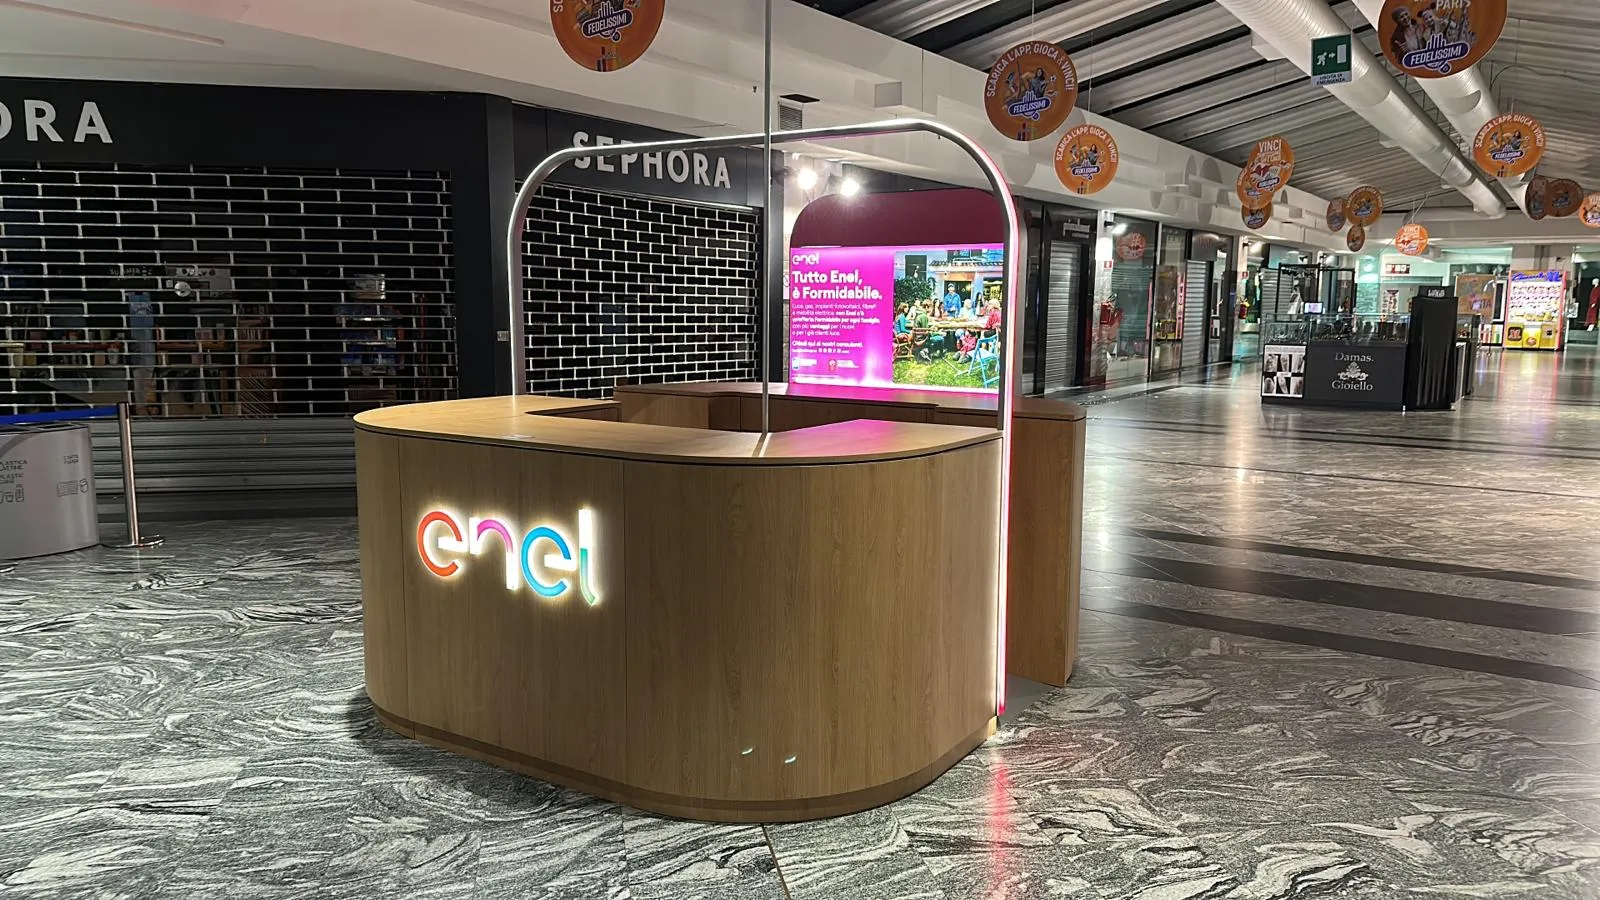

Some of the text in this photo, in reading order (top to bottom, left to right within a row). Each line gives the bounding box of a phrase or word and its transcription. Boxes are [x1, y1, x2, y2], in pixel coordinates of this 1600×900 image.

[588, 17, 627, 34] FEDELISSIMI
[1411, 45, 1462, 65] FEDELISSIMI
[987, 59, 1009, 97] SCARICA
[1033, 43, 1059, 60] GIOCA
[1061, 61, 1075, 90] VINCI!
[1013, 99, 1047, 113] FEDELISSIMI
[1475, 123, 1494, 148] SCARICA
[1513, 114, 1533, 127] GIOCA
[1056, 134, 1073, 160] SCARICA
[1090, 127, 1107, 140] GIOCA
[1258, 139, 1282, 153] VINCI
[572, 131, 731, 189] SEPHORA
[793, 253, 819, 265] enel
[792, 269, 862, 286] Tutto Enel,
[793, 286, 882, 300] è Formidabile.
[1335, 352, 1375, 362] Damas.
[1331, 380, 1373, 391] Gioiello
[417, 509, 599, 606] enel
